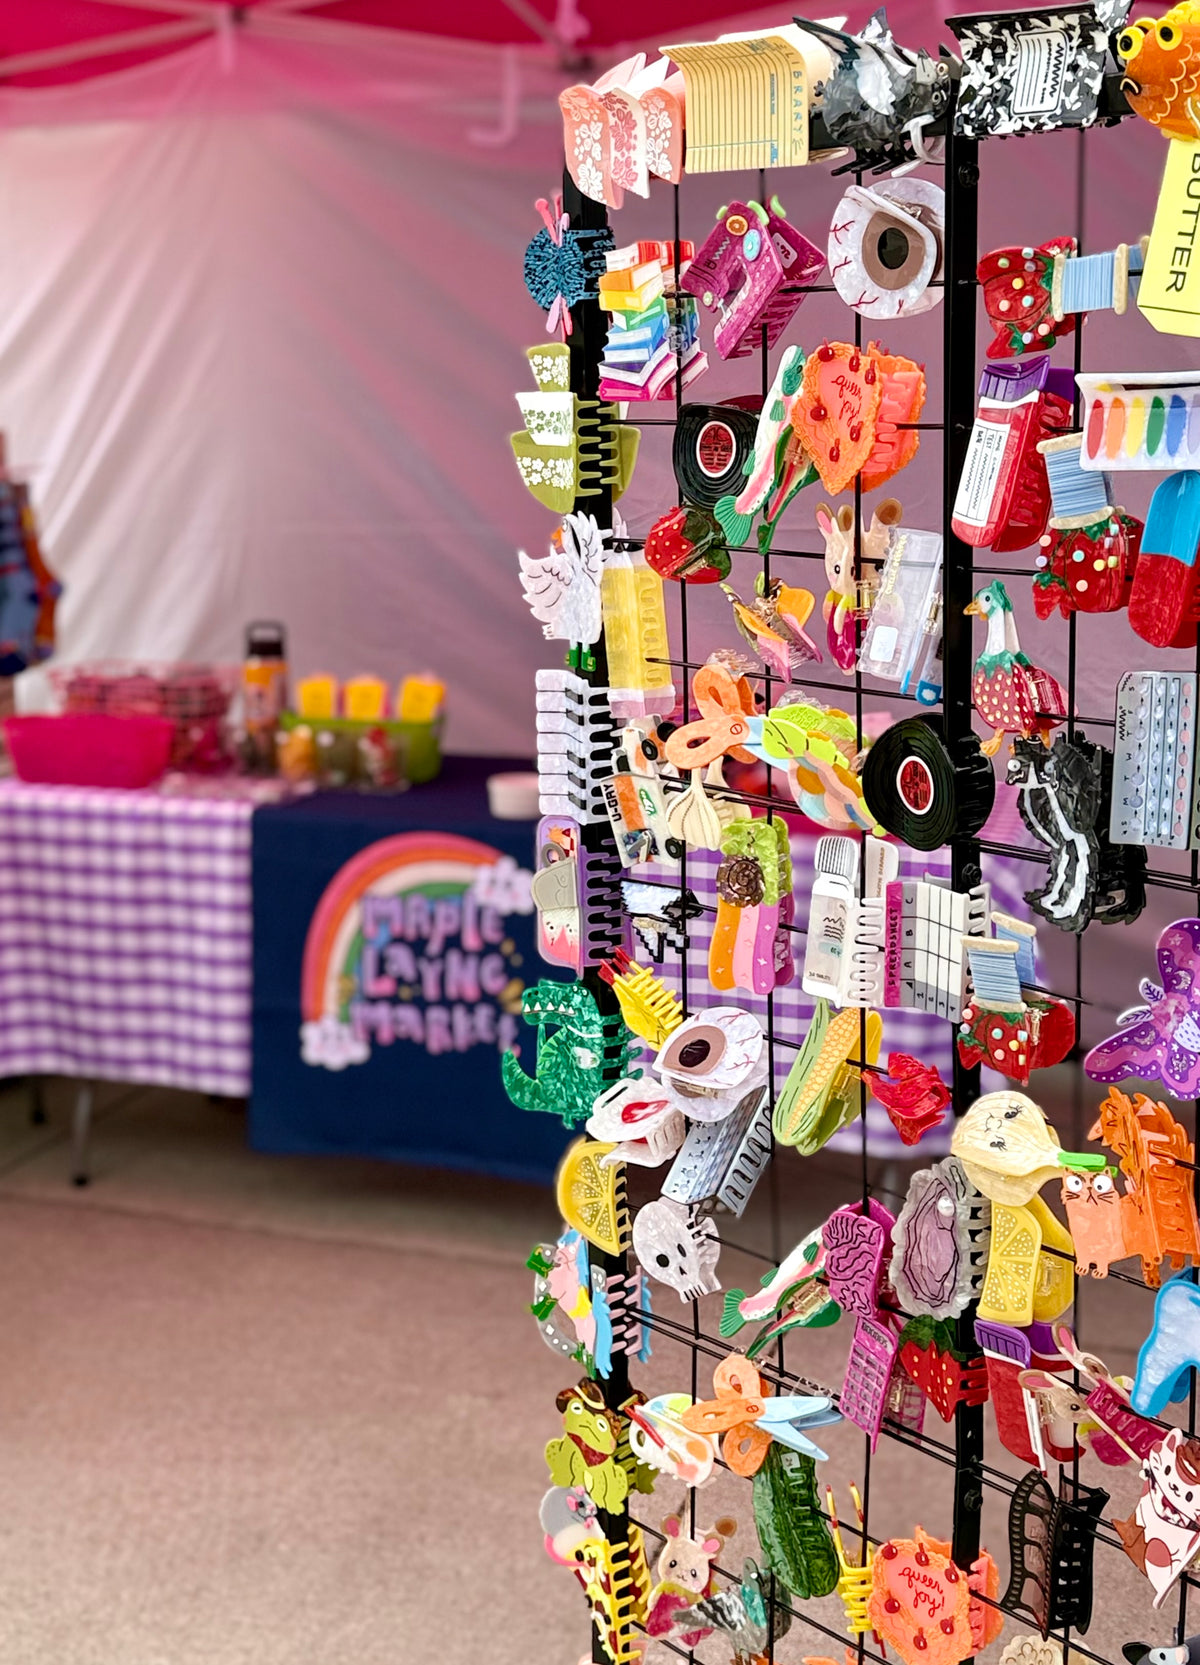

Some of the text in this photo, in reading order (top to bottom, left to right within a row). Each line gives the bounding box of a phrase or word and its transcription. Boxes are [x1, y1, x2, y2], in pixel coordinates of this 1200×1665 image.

[986, 433, 995, 449] TEST
[602, 783, 623, 822] U-GAY
[888, 908, 898, 987] SPREADSHEET
[898, 1566, 943, 1595] queer
[913, 1585, 945, 1618] joy!
